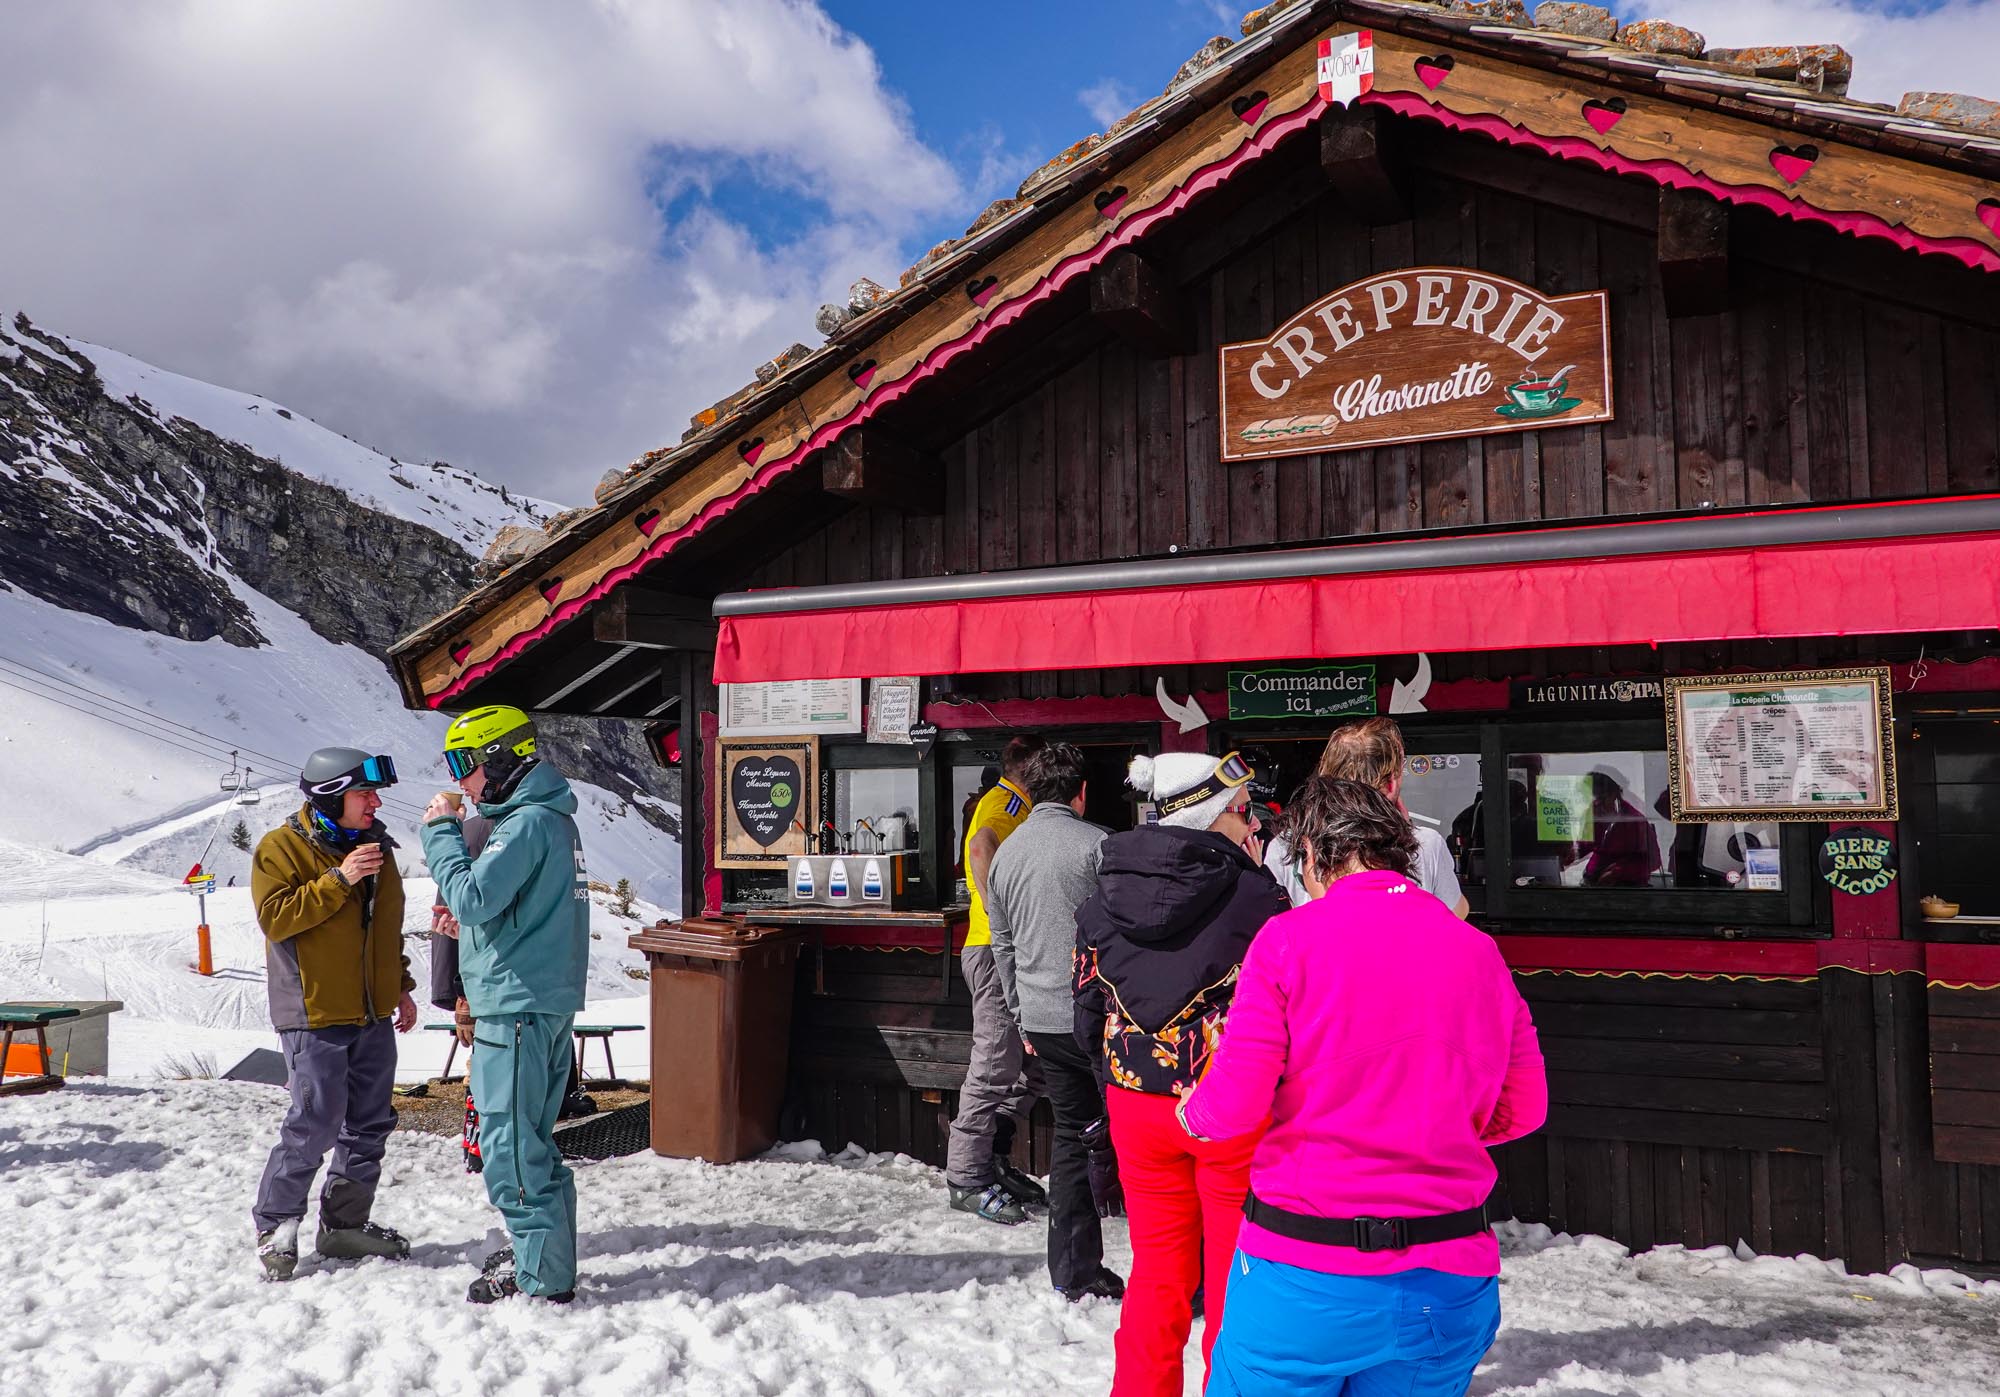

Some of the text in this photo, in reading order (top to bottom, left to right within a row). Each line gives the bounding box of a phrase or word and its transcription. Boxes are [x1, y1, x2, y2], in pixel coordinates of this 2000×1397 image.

[1320, 50, 1370, 80] AVORIAZ
[1249, 275, 1565, 399] CREPERIE
[1333, 361, 1494, 422] Chavanette
[1241, 671, 1367, 693] Commander
[1286, 692, 1311, 711] ici
[1527, 682, 1663, 702] LAGUNITAS IPA
[740, 766, 762, 779] Soupe
[745, 778, 772, 788] Maison
[737, 799, 773, 810] Homemade
[747, 809, 779, 822] Vegetable
[756, 821, 774, 835] Soup
[1824, 837, 1891, 857] BIERE
[1834, 854, 1883, 870] SANS
[1823, 867, 1898, 896] ALCOOL
